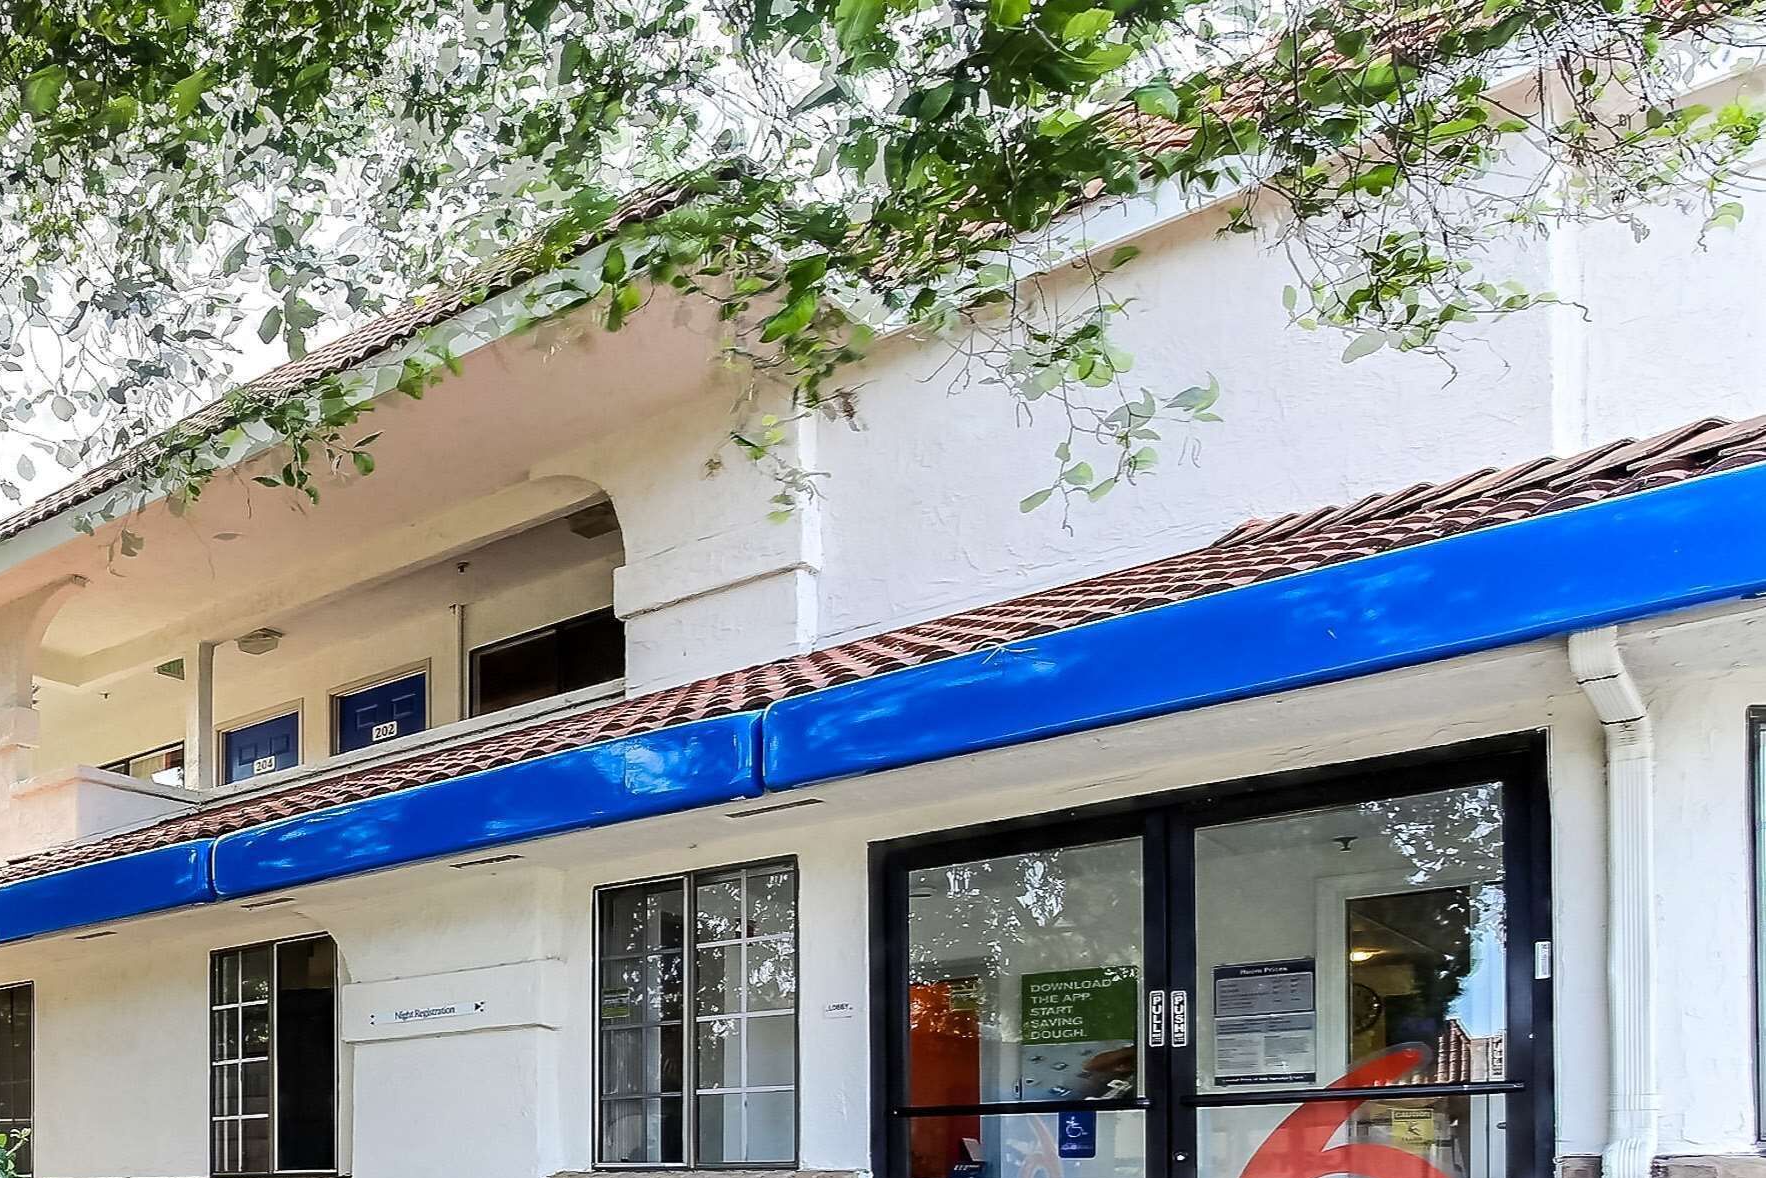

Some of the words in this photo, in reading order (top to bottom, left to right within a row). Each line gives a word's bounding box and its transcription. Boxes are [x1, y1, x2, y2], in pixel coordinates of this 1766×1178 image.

[374, 723, 395, 739] 202
[255, 760, 273, 772] 204
[1030, 979, 1112, 993] DOWNLOAD
[1031, 994, 1058, 1004] THE
[395, 1010, 414, 1021] Night
[415, 1007, 456, 1018] Registration
[1030, 1005, 1073, 1016] START
[1152, 996, 1162, 1033] PULL
[1174, 996, 1185, 1033] PUSH
[1031, 1016, 1083, 1029] SAVING
[1031, 1028, 1087, 1040] DOUGH.
